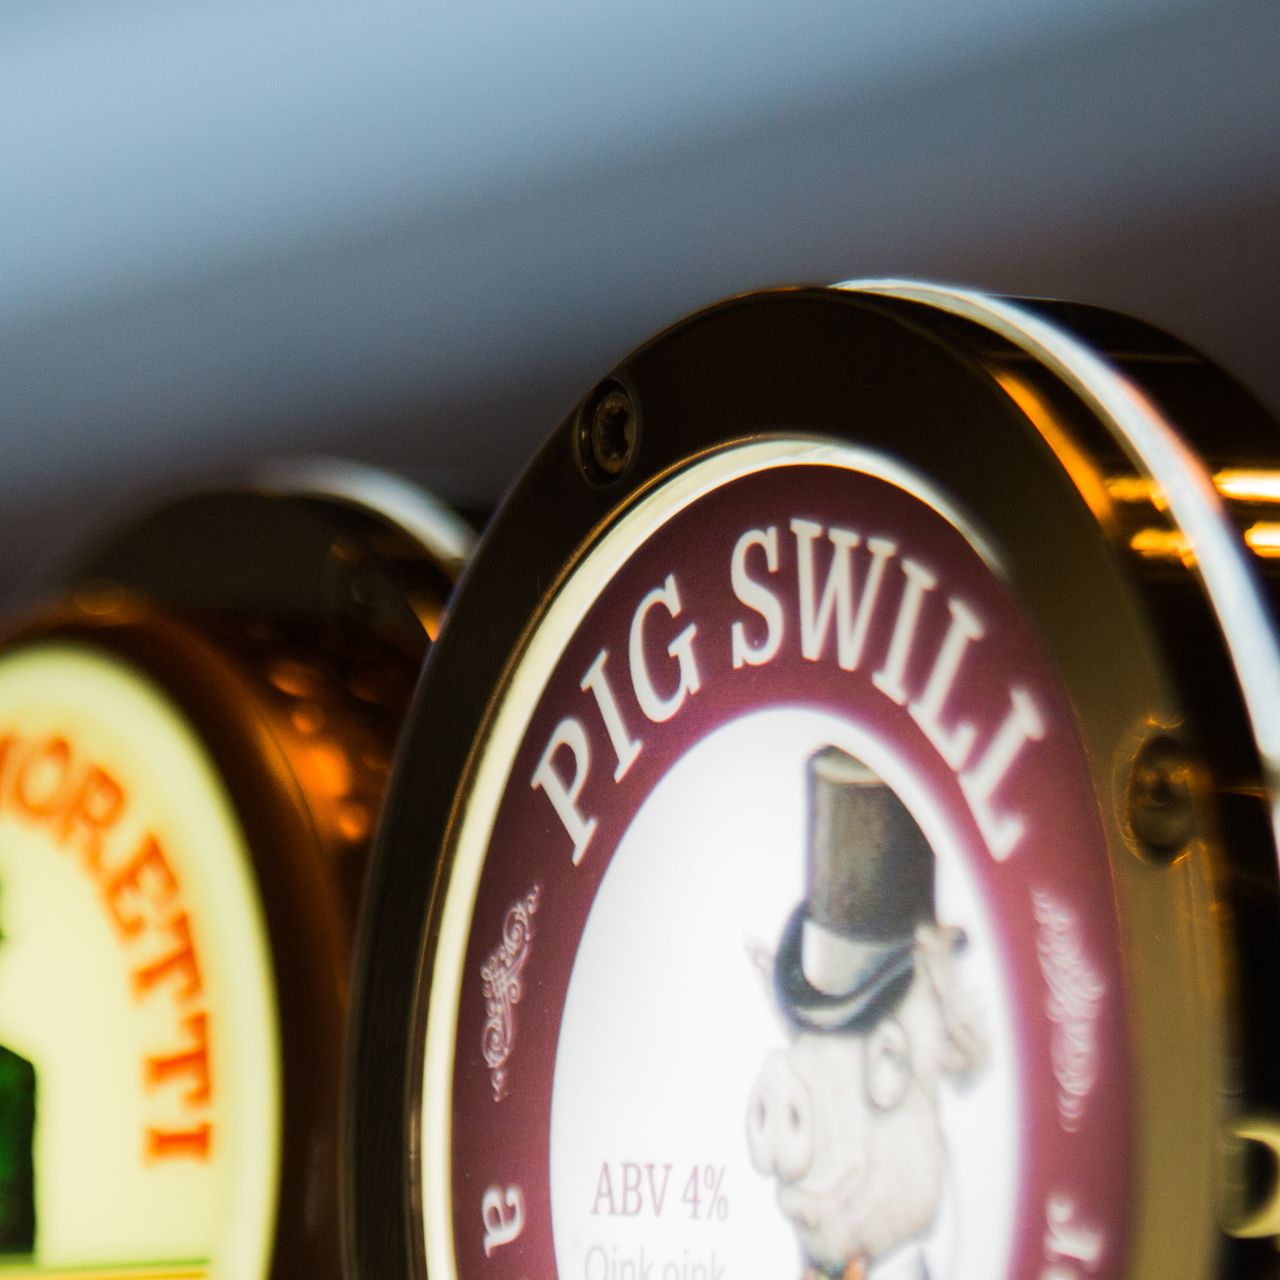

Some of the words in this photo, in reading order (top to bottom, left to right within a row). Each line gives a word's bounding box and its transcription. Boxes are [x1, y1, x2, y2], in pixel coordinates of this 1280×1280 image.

[531, 574, 702, 866] PIG
[730, 517, 1045, 862] SWILL
[482, 1185, 526, 1257] a
[590, 1160, 672, 1218] ABV
[682, 1164, 728, 1221] 4%
